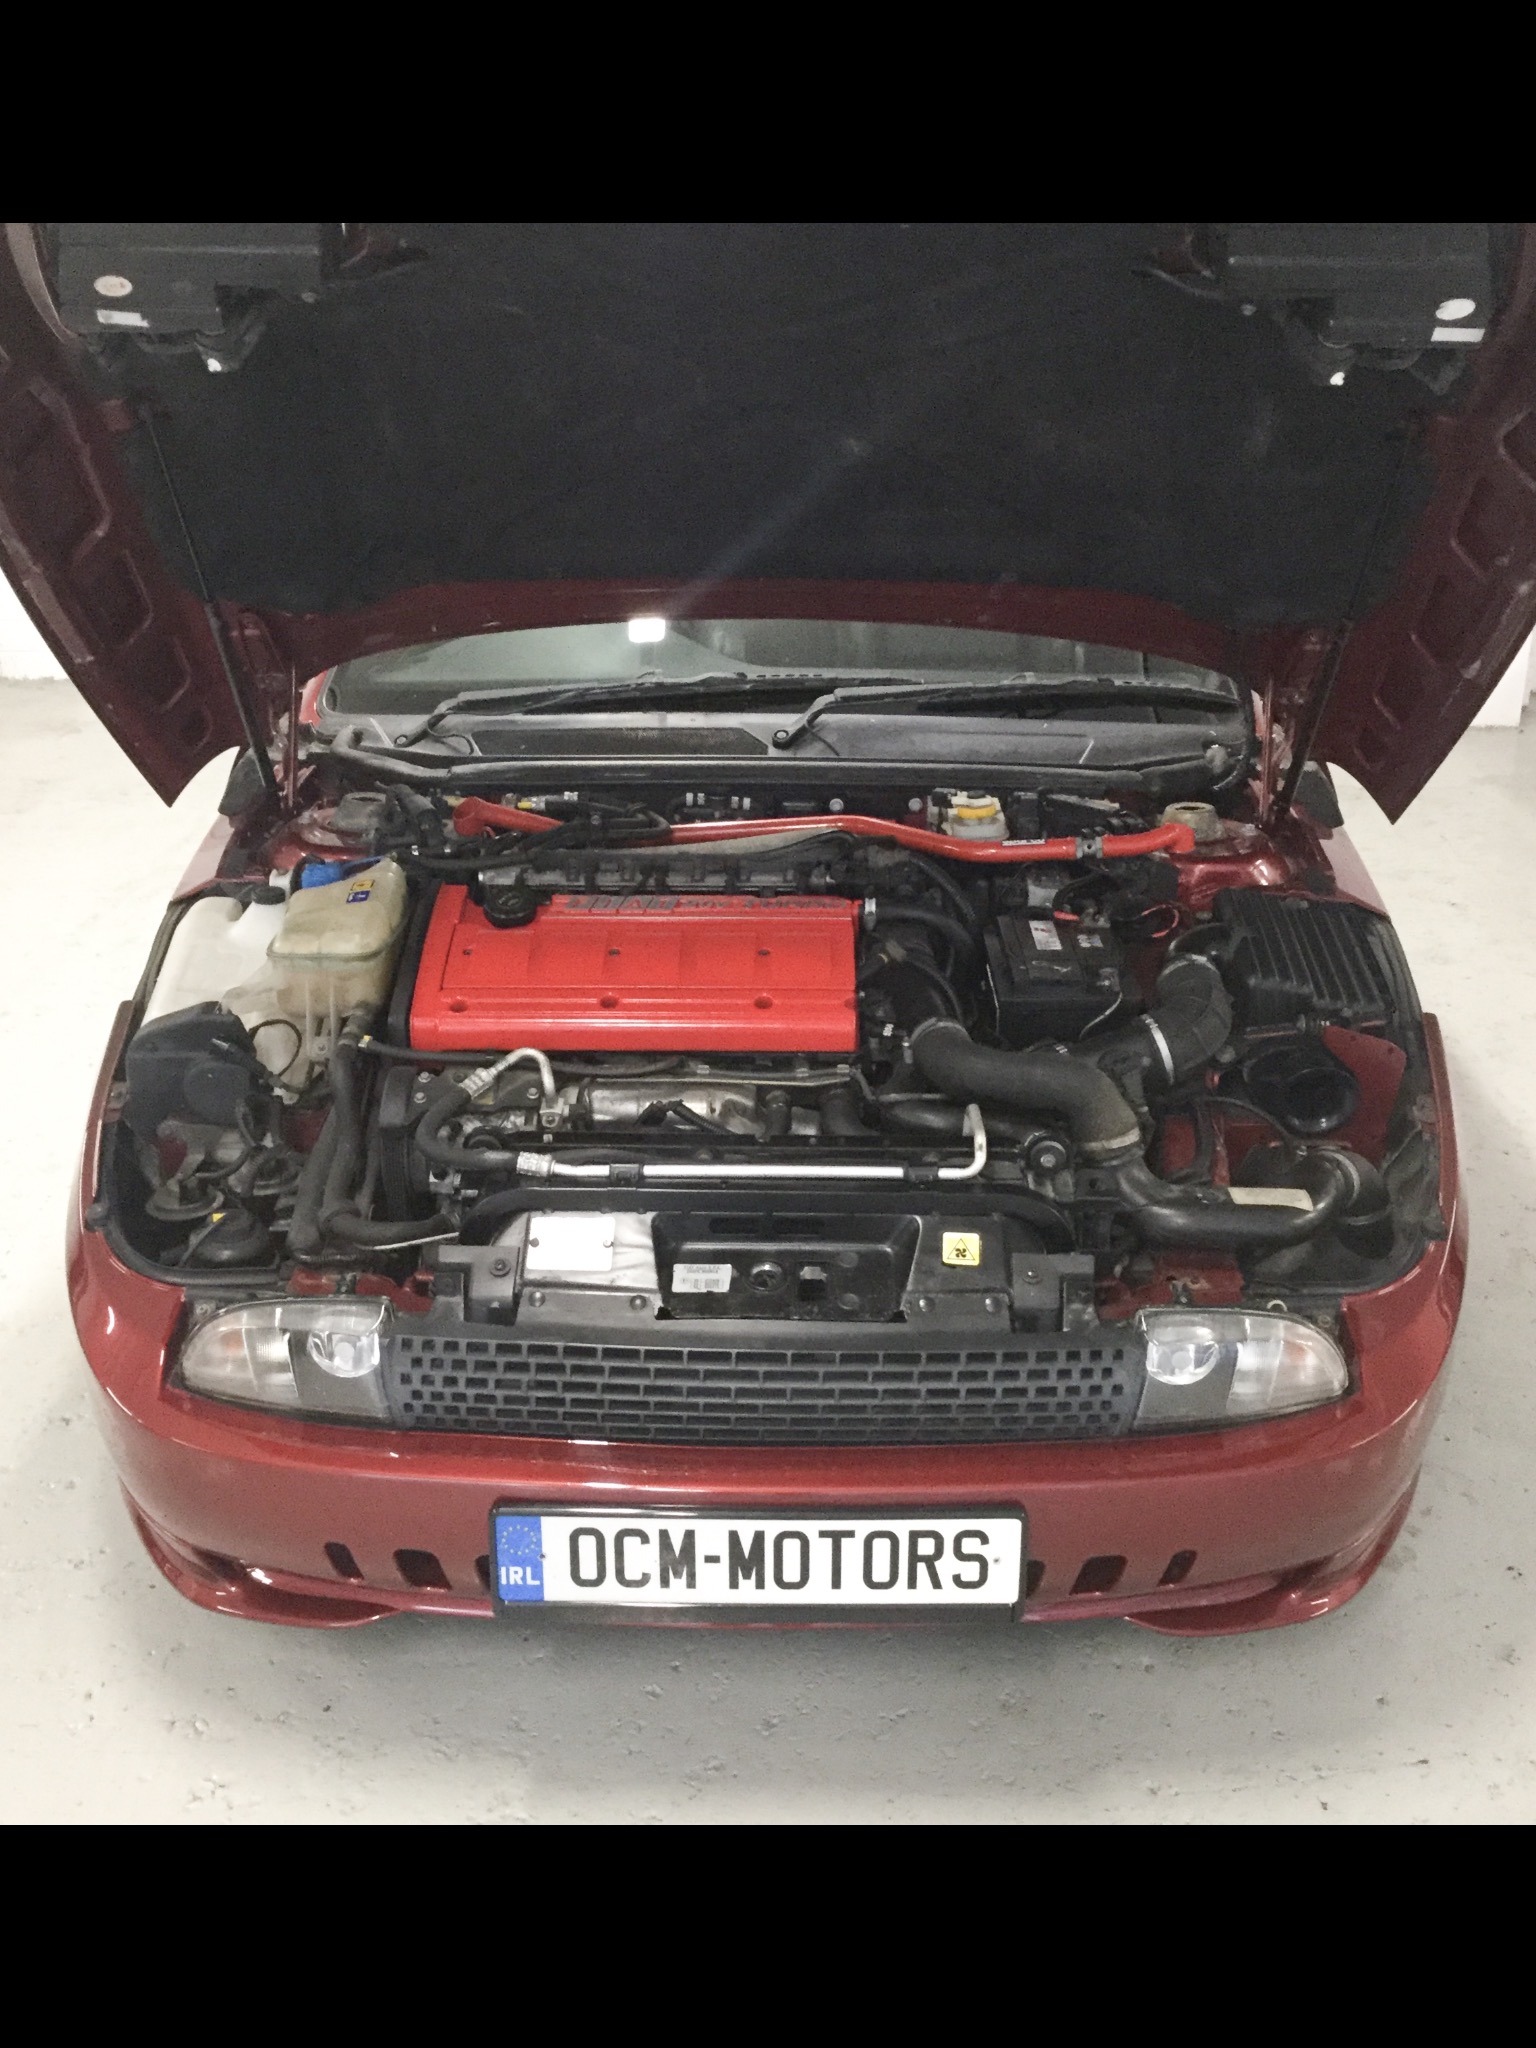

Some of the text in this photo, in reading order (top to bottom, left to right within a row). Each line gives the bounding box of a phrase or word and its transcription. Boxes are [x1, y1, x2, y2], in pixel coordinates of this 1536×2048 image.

[565, 894, 681, 910] FIAT
[569, 1527, 990, 1590] OCM-MOTORS
[500, 1566, 541, 1586] IRL
